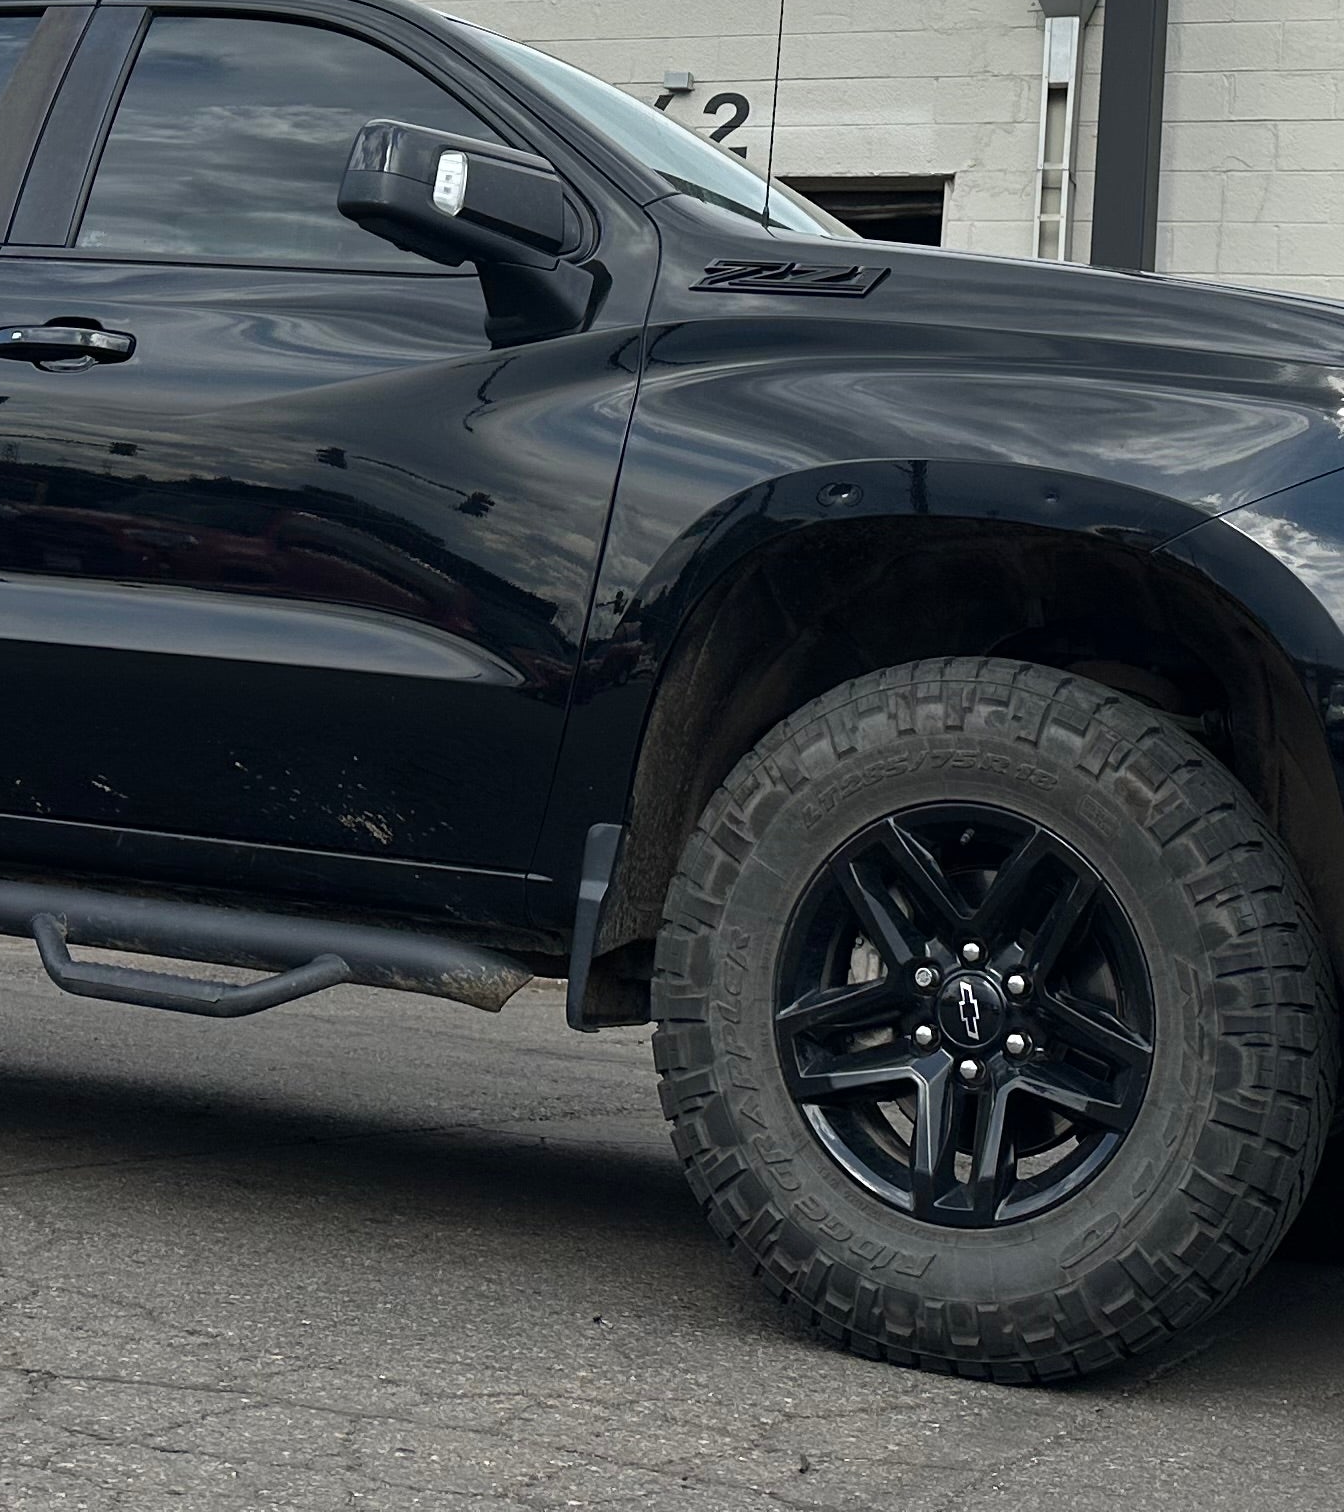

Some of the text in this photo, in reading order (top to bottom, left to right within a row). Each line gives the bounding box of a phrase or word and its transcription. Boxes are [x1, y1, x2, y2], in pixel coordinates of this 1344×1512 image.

[702, 92, 751, 160] 2
[688, 257, 892, 300] Z71
[793, 1193, 939, 1280] RIDGE
